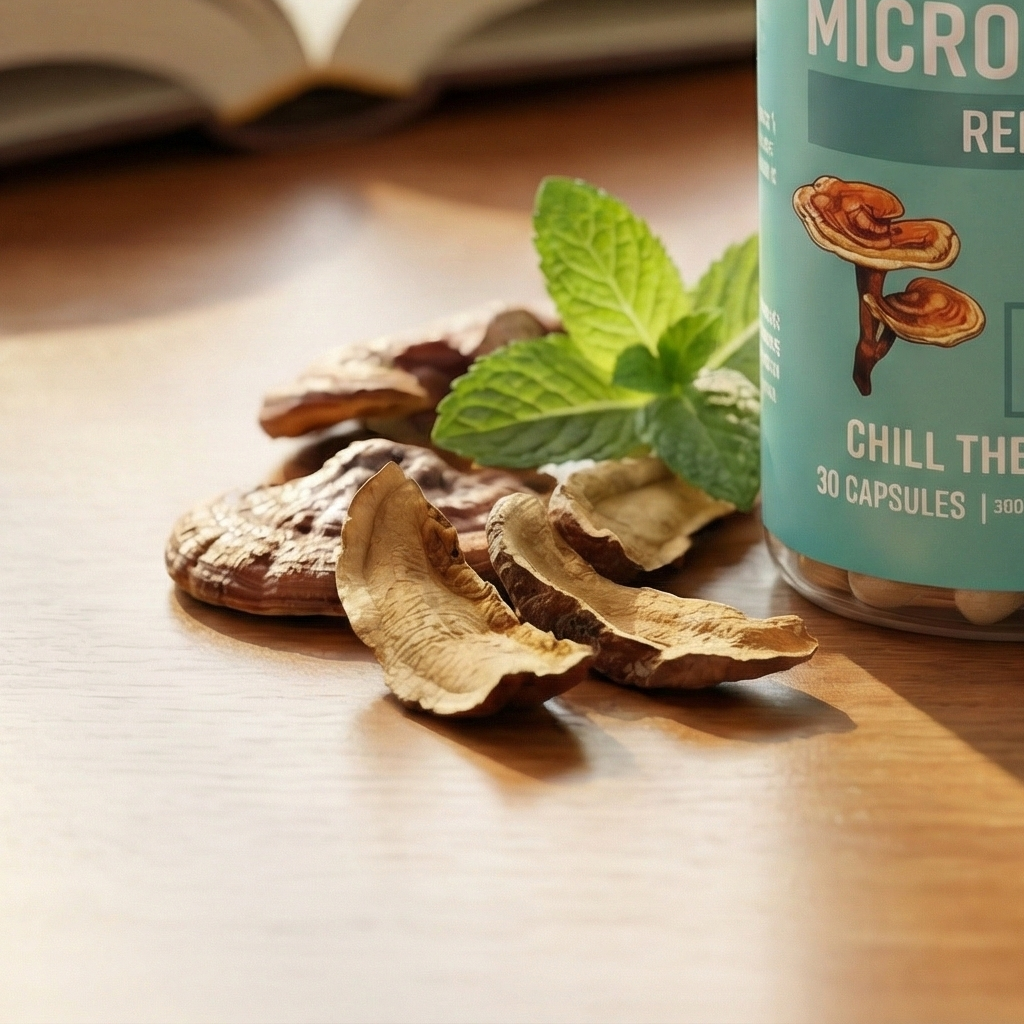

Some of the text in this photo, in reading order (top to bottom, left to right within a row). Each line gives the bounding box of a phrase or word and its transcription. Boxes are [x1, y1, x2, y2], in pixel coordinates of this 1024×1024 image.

[847, 418, 945, 472] CHILL
[816, 465, 840, 498] 30
[845, 475, 966, 520] CAPSULES
